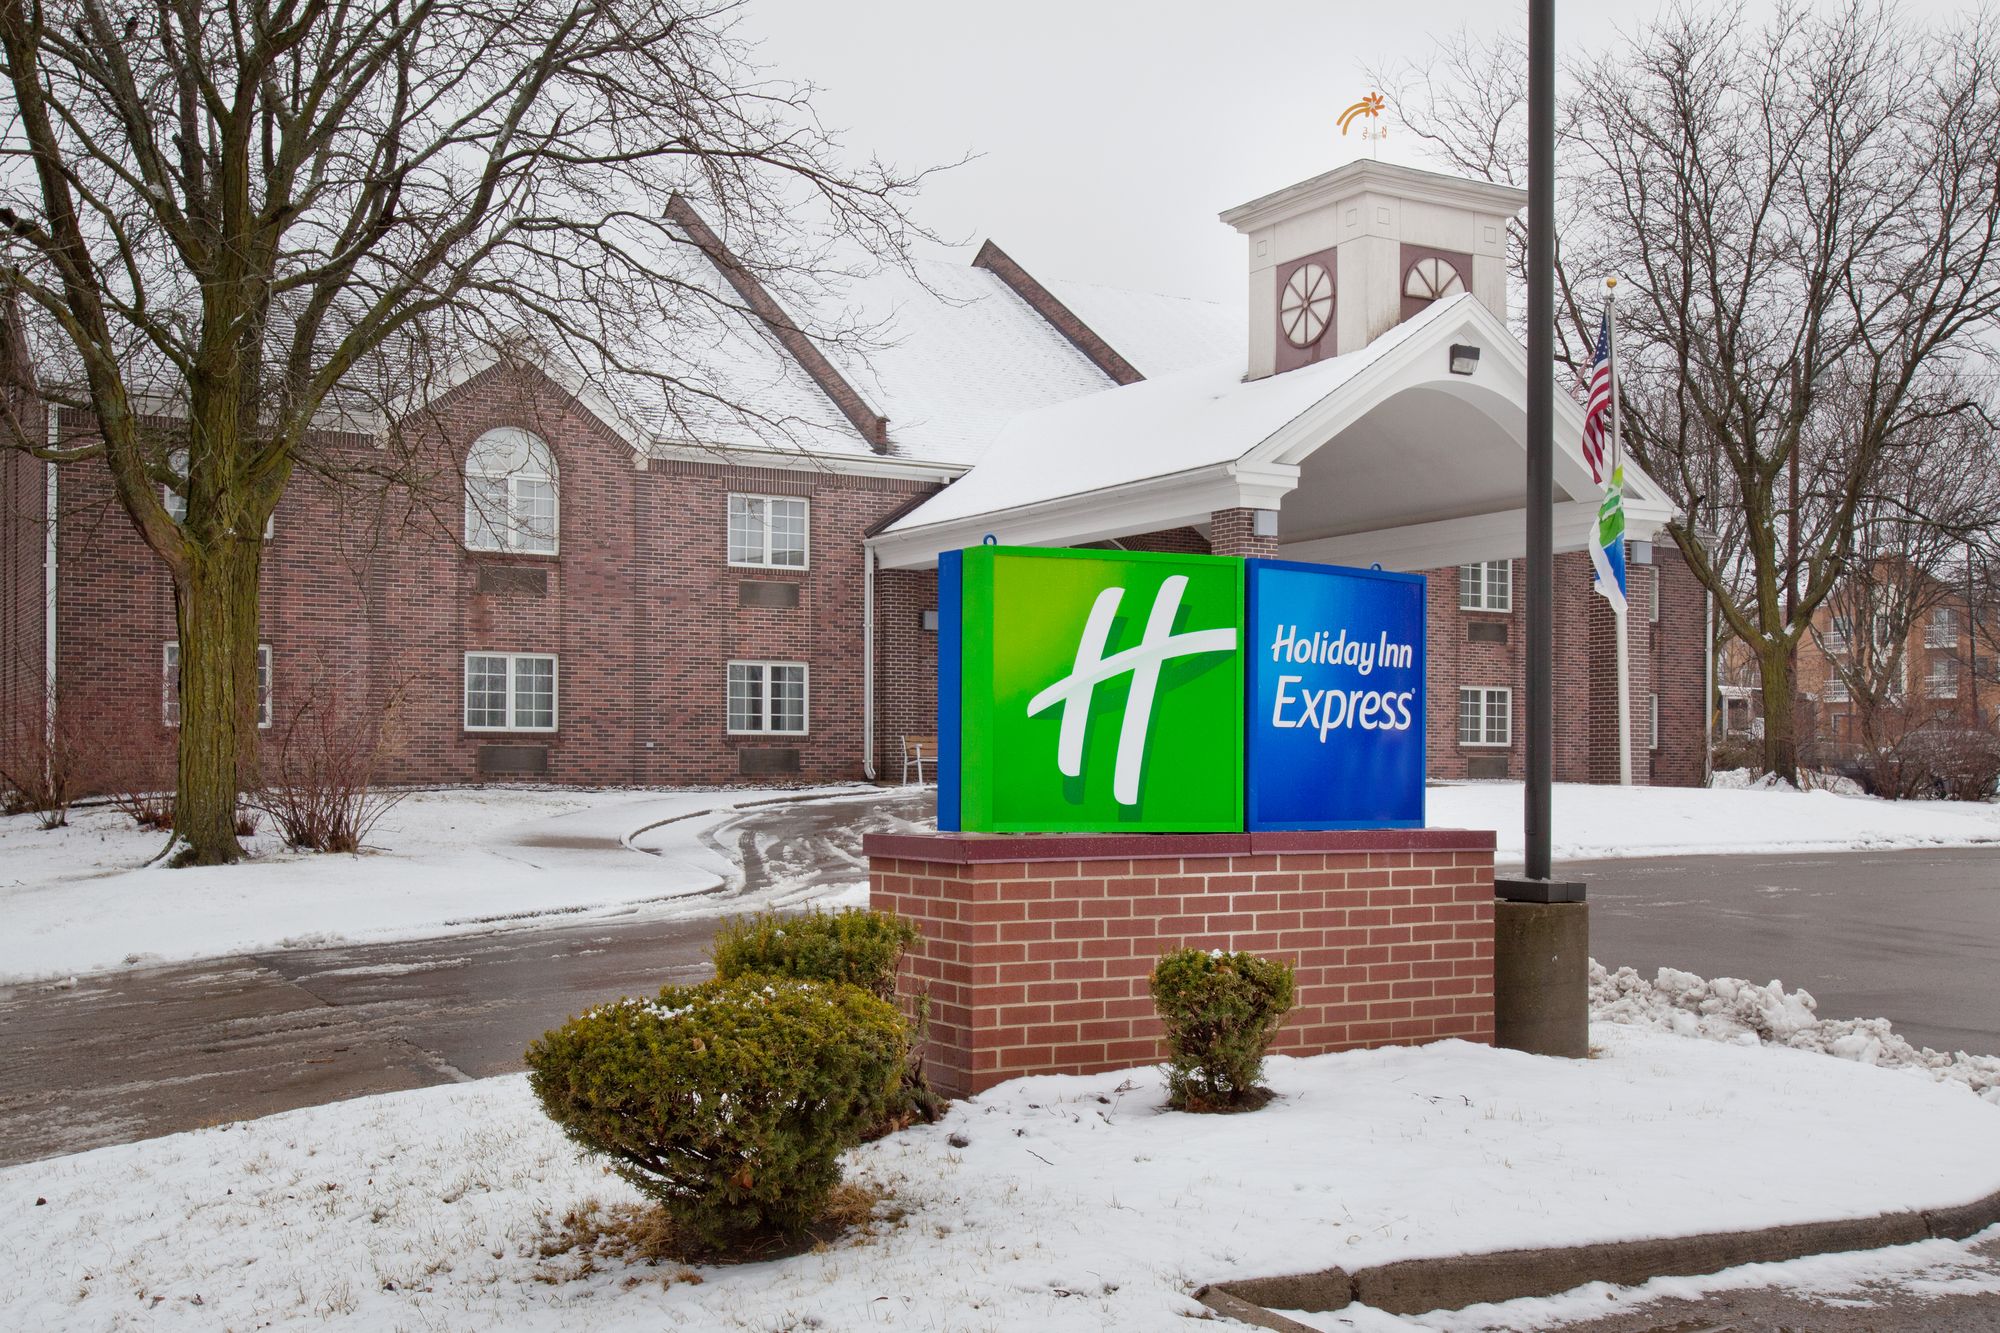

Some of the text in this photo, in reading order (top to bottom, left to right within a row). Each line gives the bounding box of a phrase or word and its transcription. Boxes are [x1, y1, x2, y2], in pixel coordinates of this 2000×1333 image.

[1270, 623, 1413, 676] Holiday Inn
[1026, 574, 1237, 806] H
[1272, 674, 1413, 744] Express
